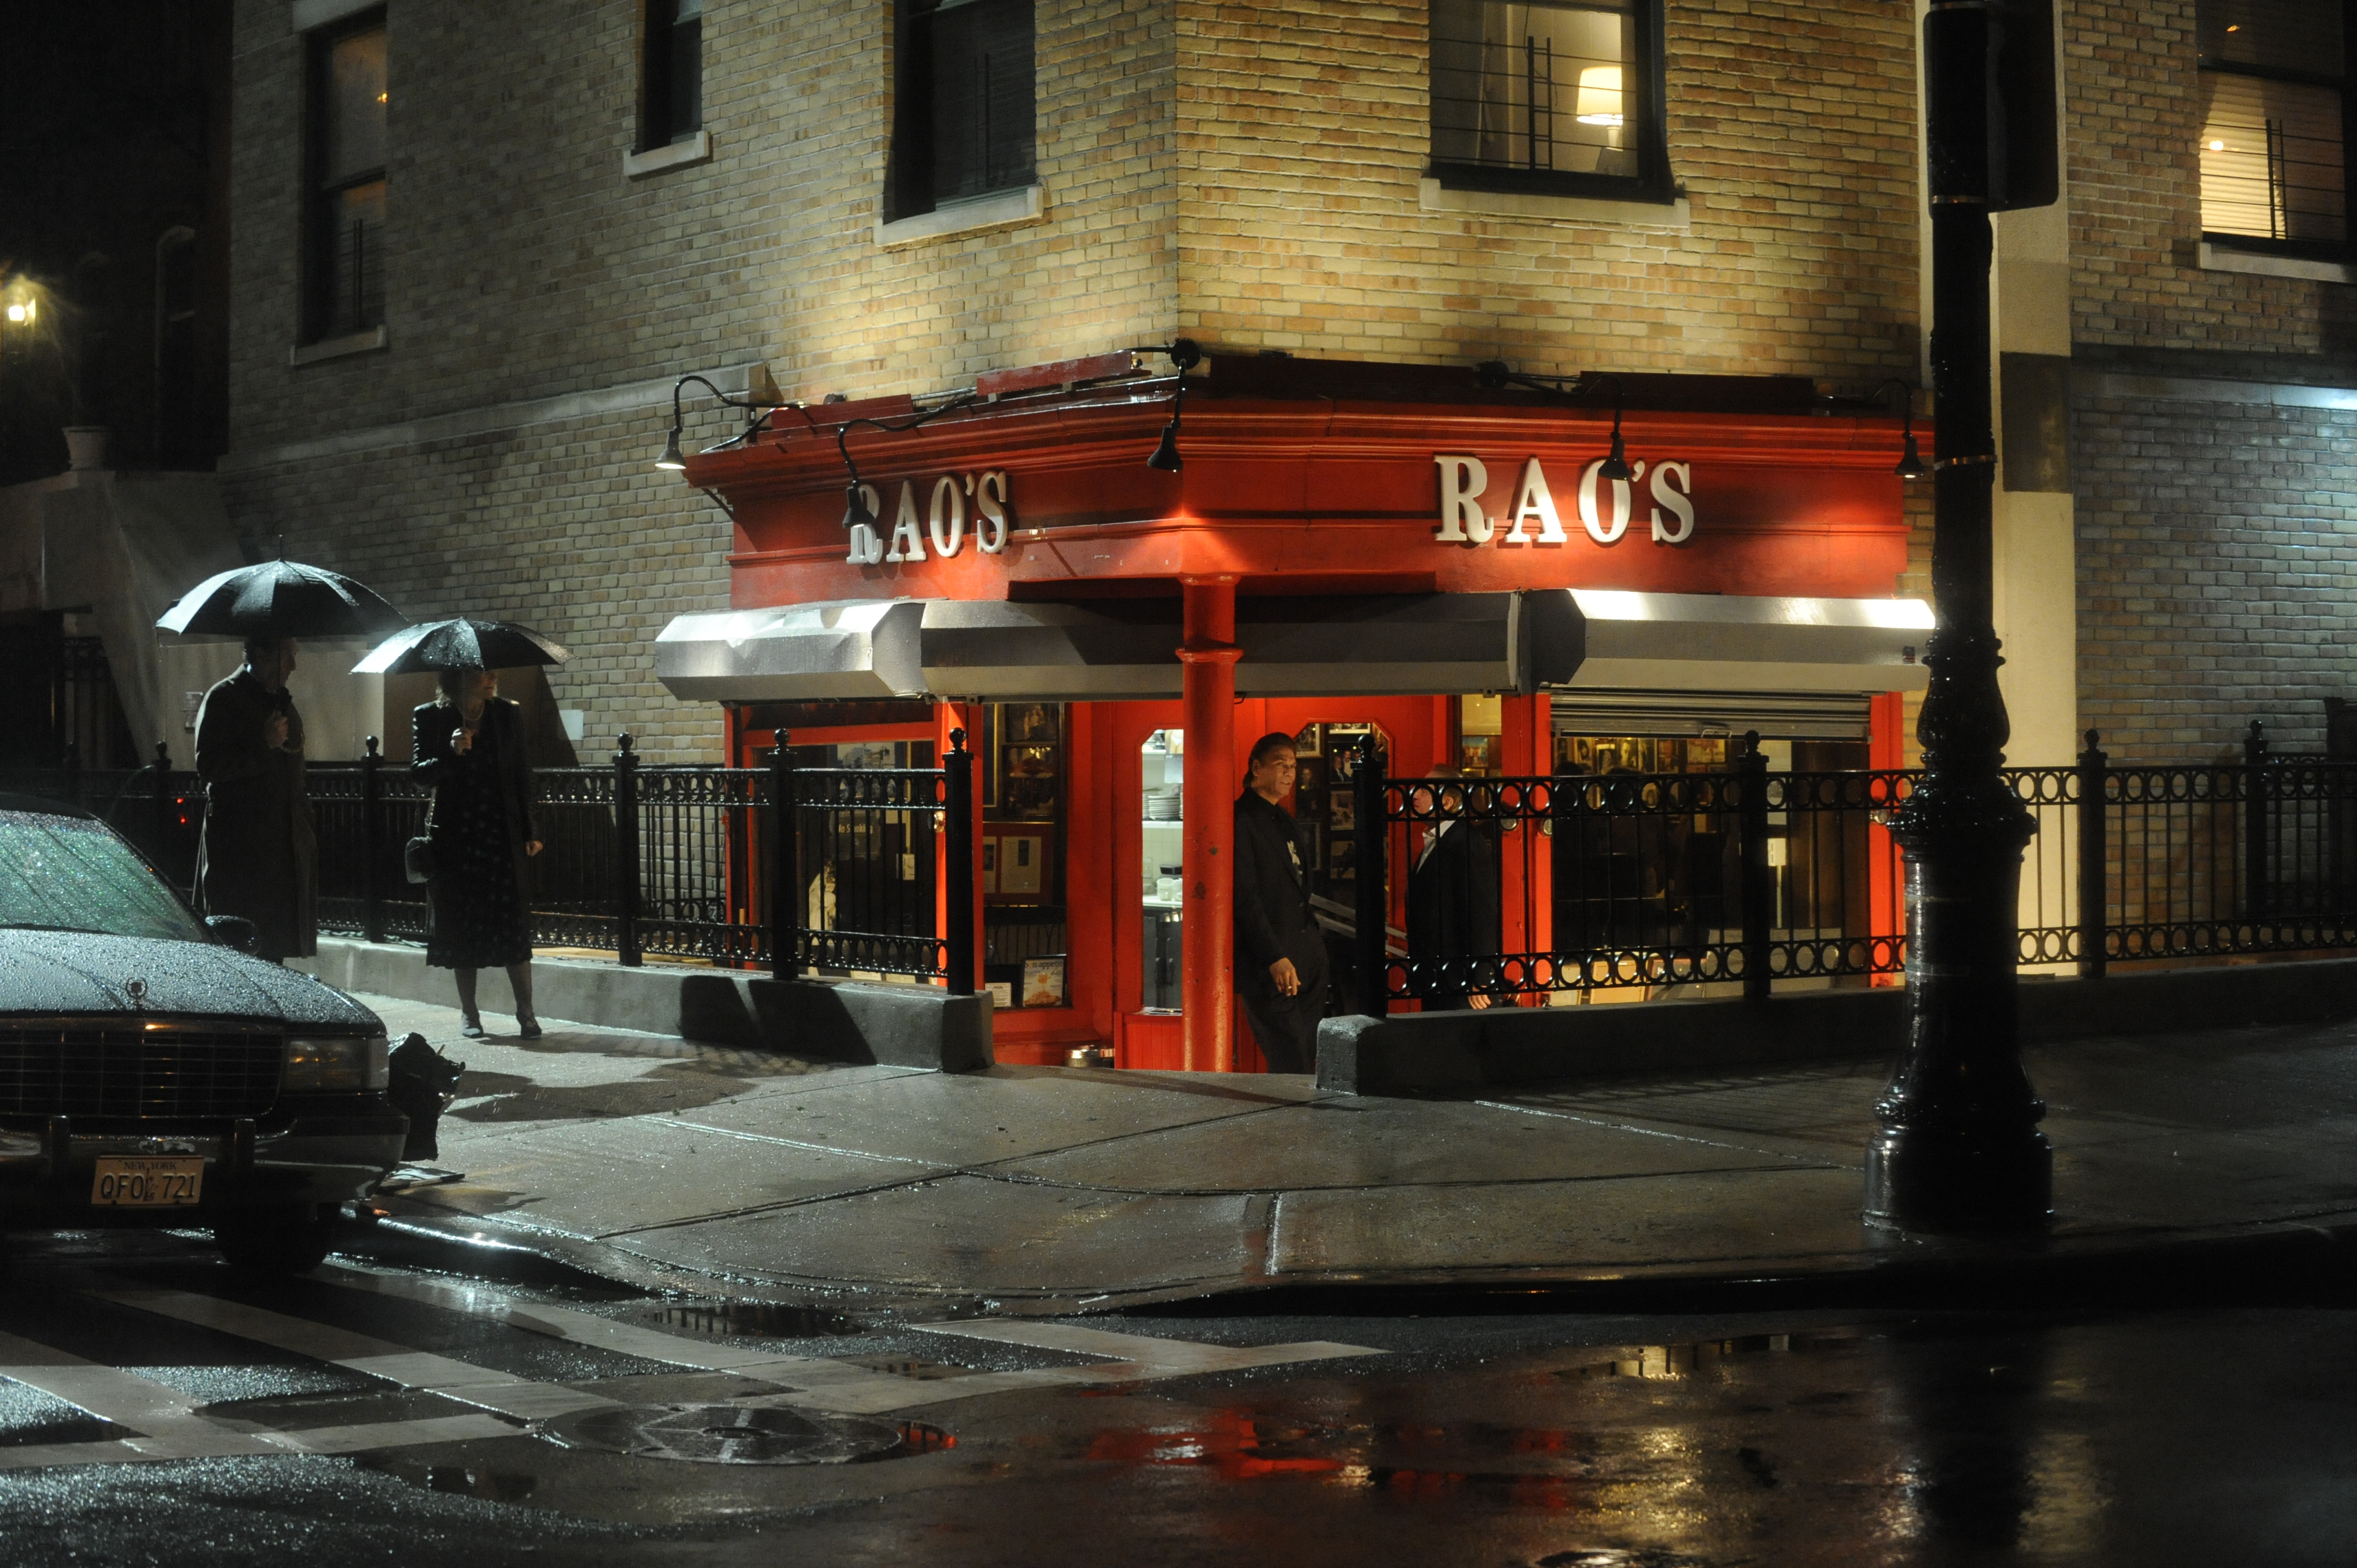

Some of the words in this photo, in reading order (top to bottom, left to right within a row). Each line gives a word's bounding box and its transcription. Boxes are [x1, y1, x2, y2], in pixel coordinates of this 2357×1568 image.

[1434, 456, 1694, 543] RAO'S
[846, 471, 1008, 564] RAO'S
[846, 824, 873, 834] Sokig
[123, 1162, 146, 1170] NEW
[150, 1161, 176, 1170] YORK
[162, 1173, 195, 1199] 721
